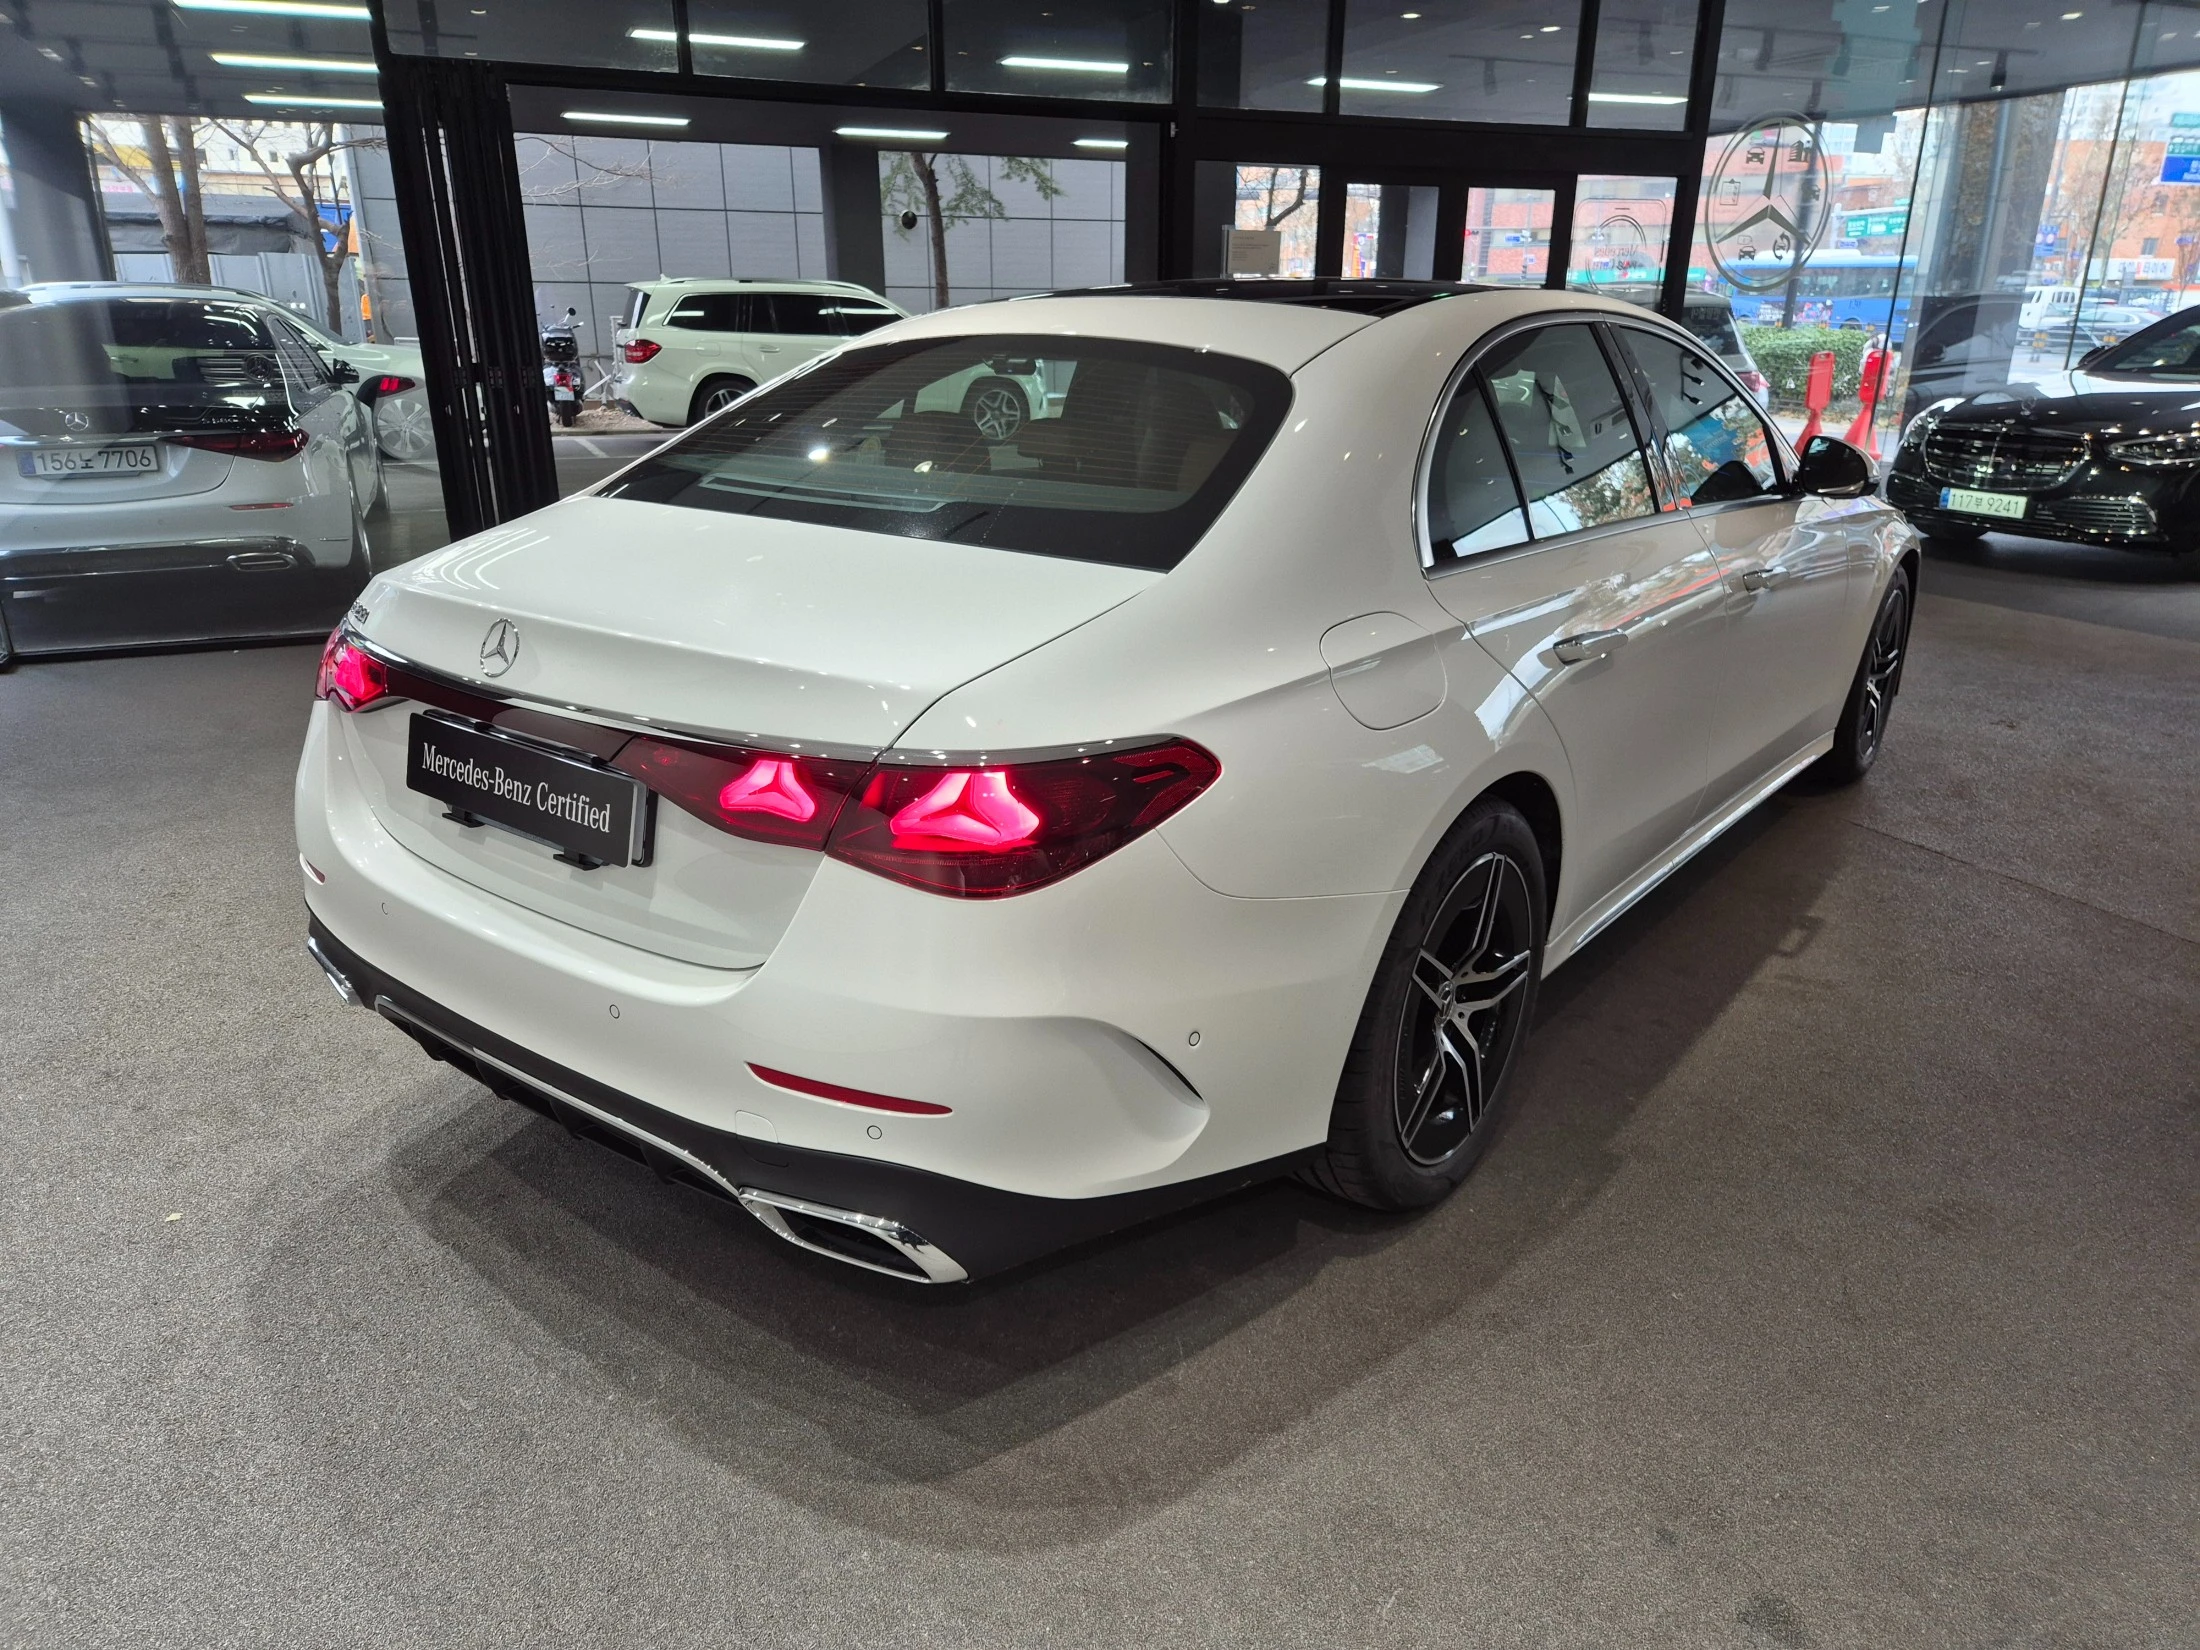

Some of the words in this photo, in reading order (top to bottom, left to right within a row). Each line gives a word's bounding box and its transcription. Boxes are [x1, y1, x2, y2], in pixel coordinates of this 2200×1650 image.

[37, 452, 94, 471] 156노
[98, 449, 152, 468] 7706
[1987, 497, 2019, 514] 9241
[422, 742, 532, 806] Mercedes-Benz
[537, 782, 611, 833] Certified
